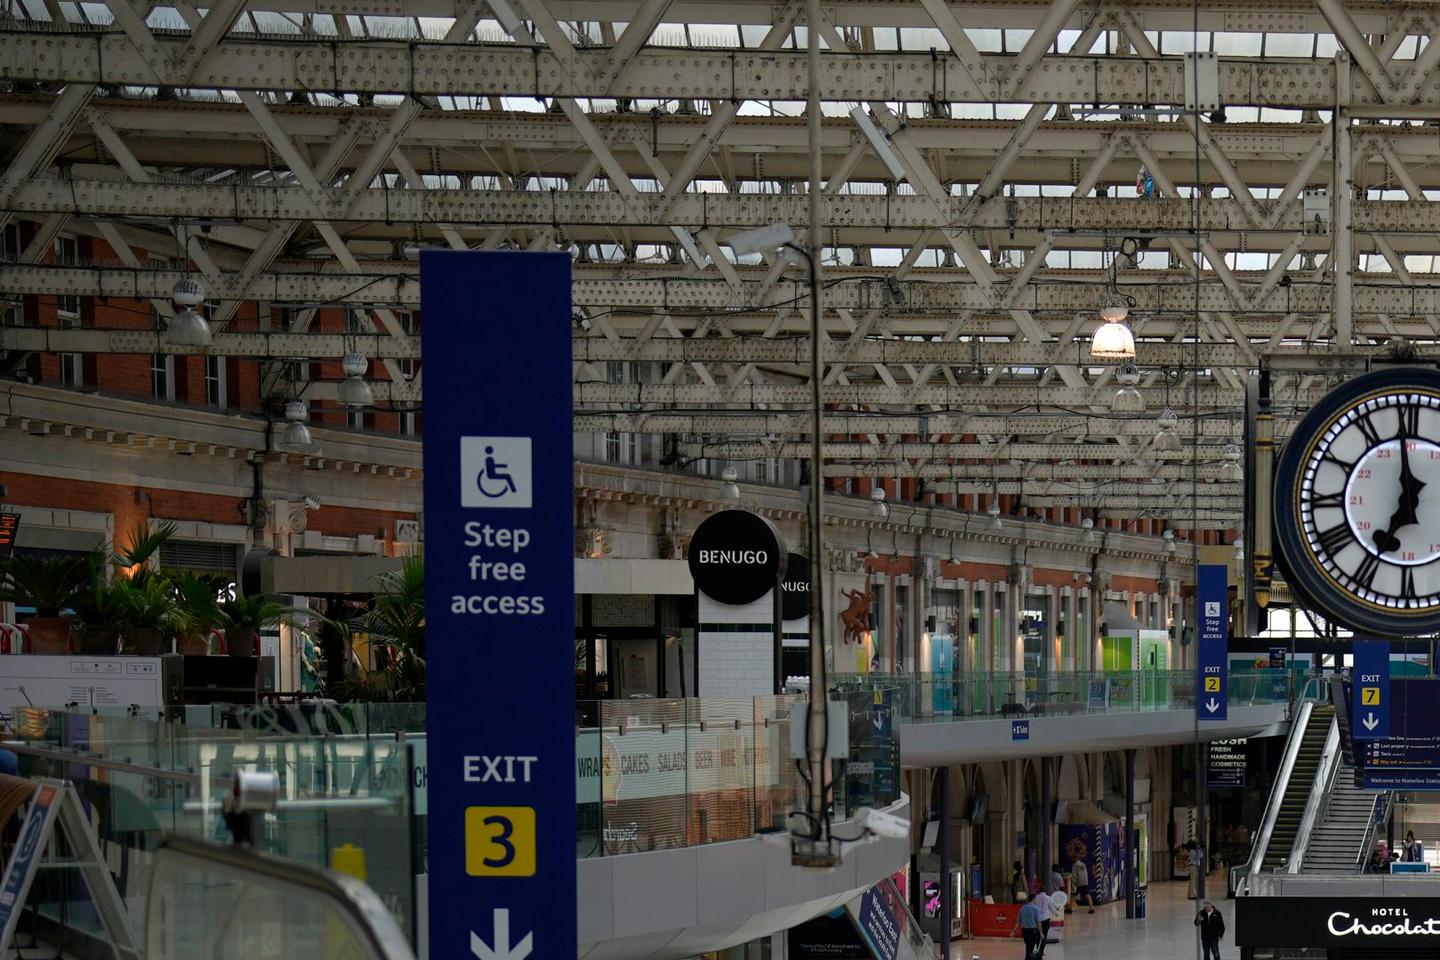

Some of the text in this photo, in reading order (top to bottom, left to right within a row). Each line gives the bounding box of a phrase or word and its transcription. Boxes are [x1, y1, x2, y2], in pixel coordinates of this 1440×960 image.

[1377, 449, 1391, 459] 23
[1357, 469, 1372, 479] 22
[1350, 495, 1364, 505] 21
[1357, 521, 1371, 531] 20
[464, 521, 531, 553] Step
[699, 550, 768, 565] BENUGO
[1402, 551, 1415, 561] 18
[468, 554, 527, 581] free
[450, 594, 545, 615] access
[1205, 619, 1220, 627] Step
[1361, 674, 1381, 683] EXIT
[1208, 679, 1217, 690] 2
[1366, 689, 1376, 703] 7
[463, 755, 539, 783] EXIT
[621, 752, 649, 776] CAKES
[483, 815, 516, 868] 3
[1372, 908, 1408, 916] HOTEL
